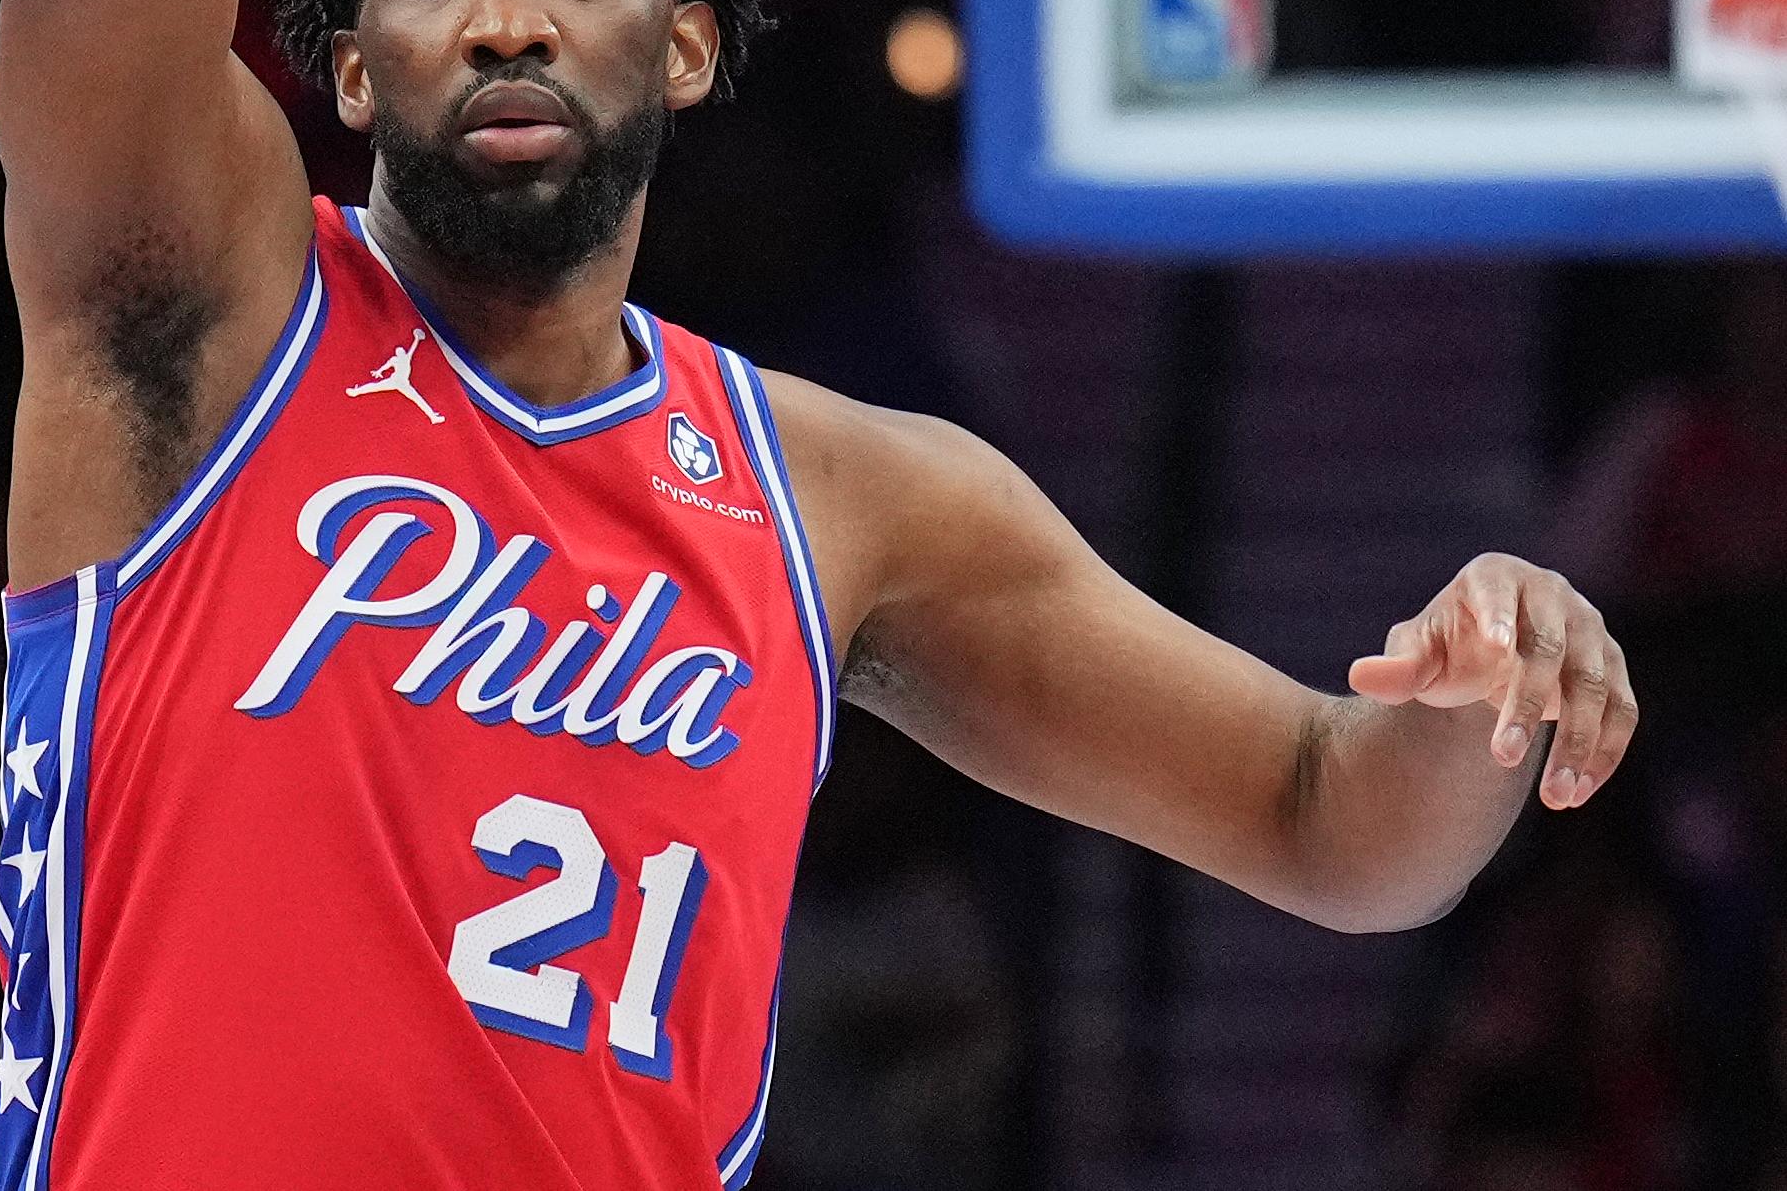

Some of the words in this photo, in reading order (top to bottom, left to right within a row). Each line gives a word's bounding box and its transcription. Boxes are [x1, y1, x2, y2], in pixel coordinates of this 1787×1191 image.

[233, 474, 754, 770] Phila
[651, 475, 764, 524] crypto.com
[446, 793, 711, 1084] 21
